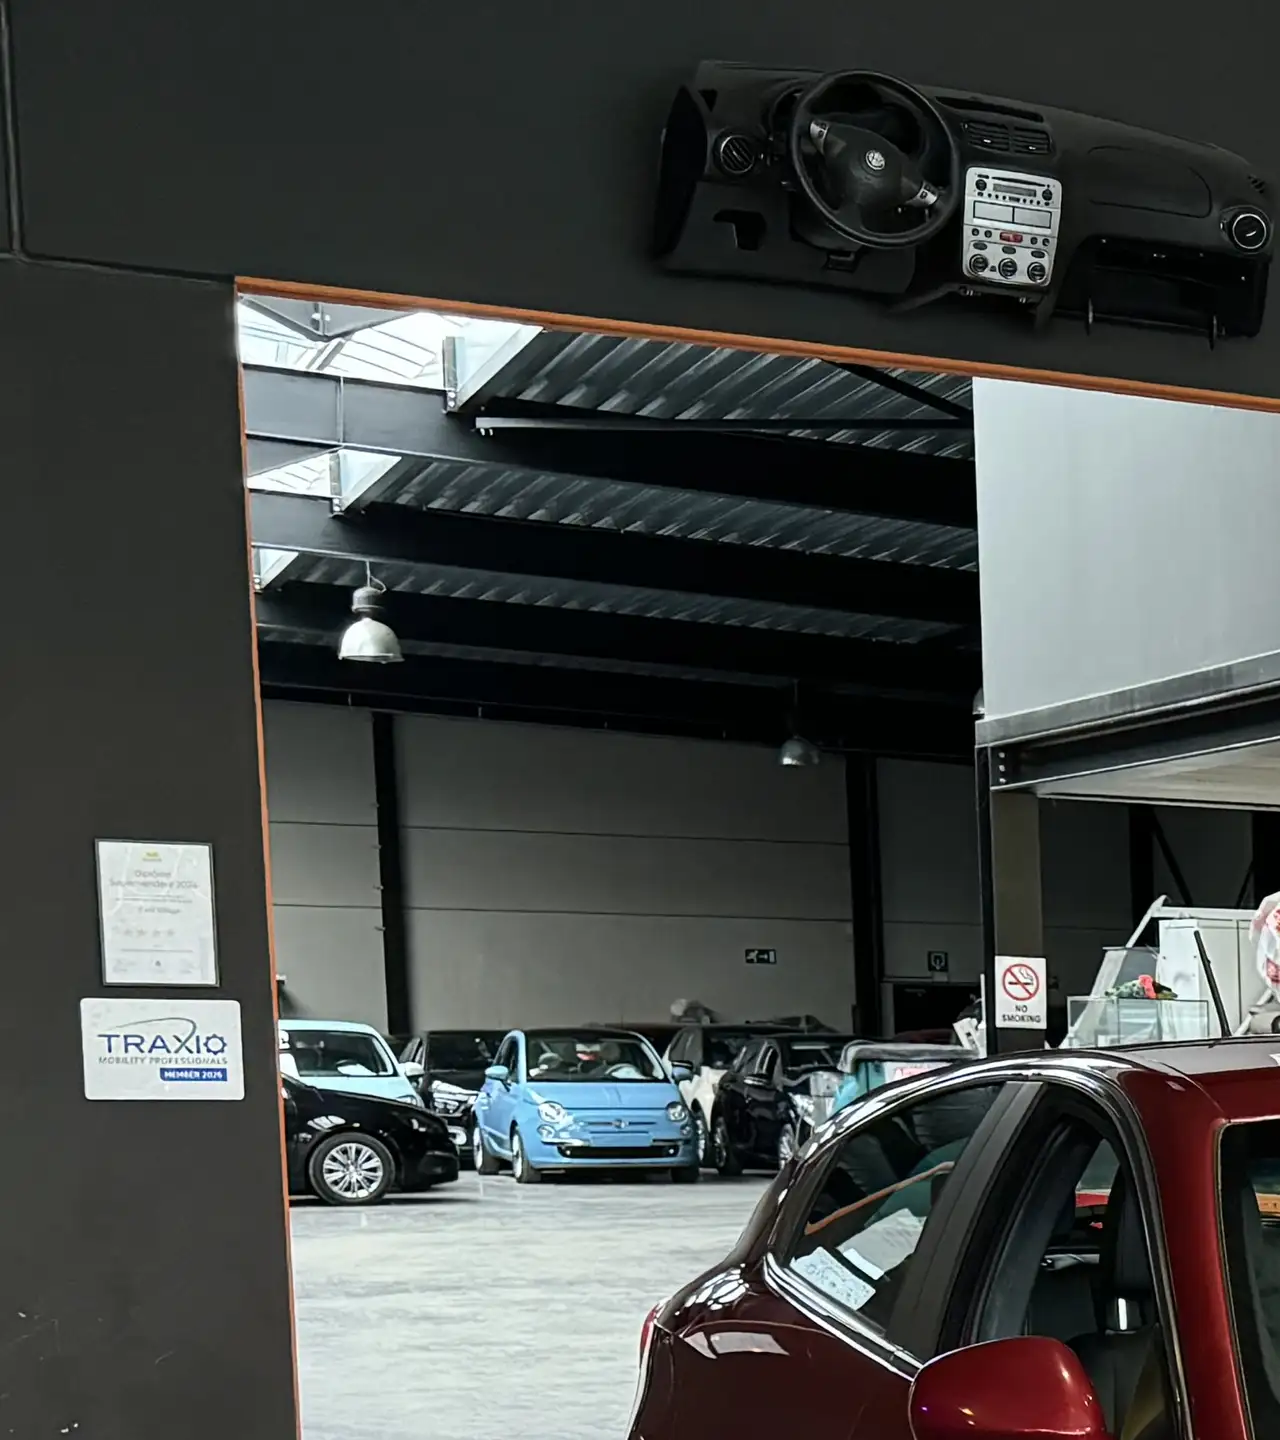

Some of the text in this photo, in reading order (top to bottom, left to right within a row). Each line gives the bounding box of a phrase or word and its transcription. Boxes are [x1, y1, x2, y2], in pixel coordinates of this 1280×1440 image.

[1015, 1005, 1028, 1013] NO
[1002, 1014, 1041, 1023] SMOKING
[97, 1033, 228, 1056] TRAXIO
[99, 1056, 228, 1065] MOBILITY PROFESSIONALS
[164, 1070, 200, 1079] MEMBER
